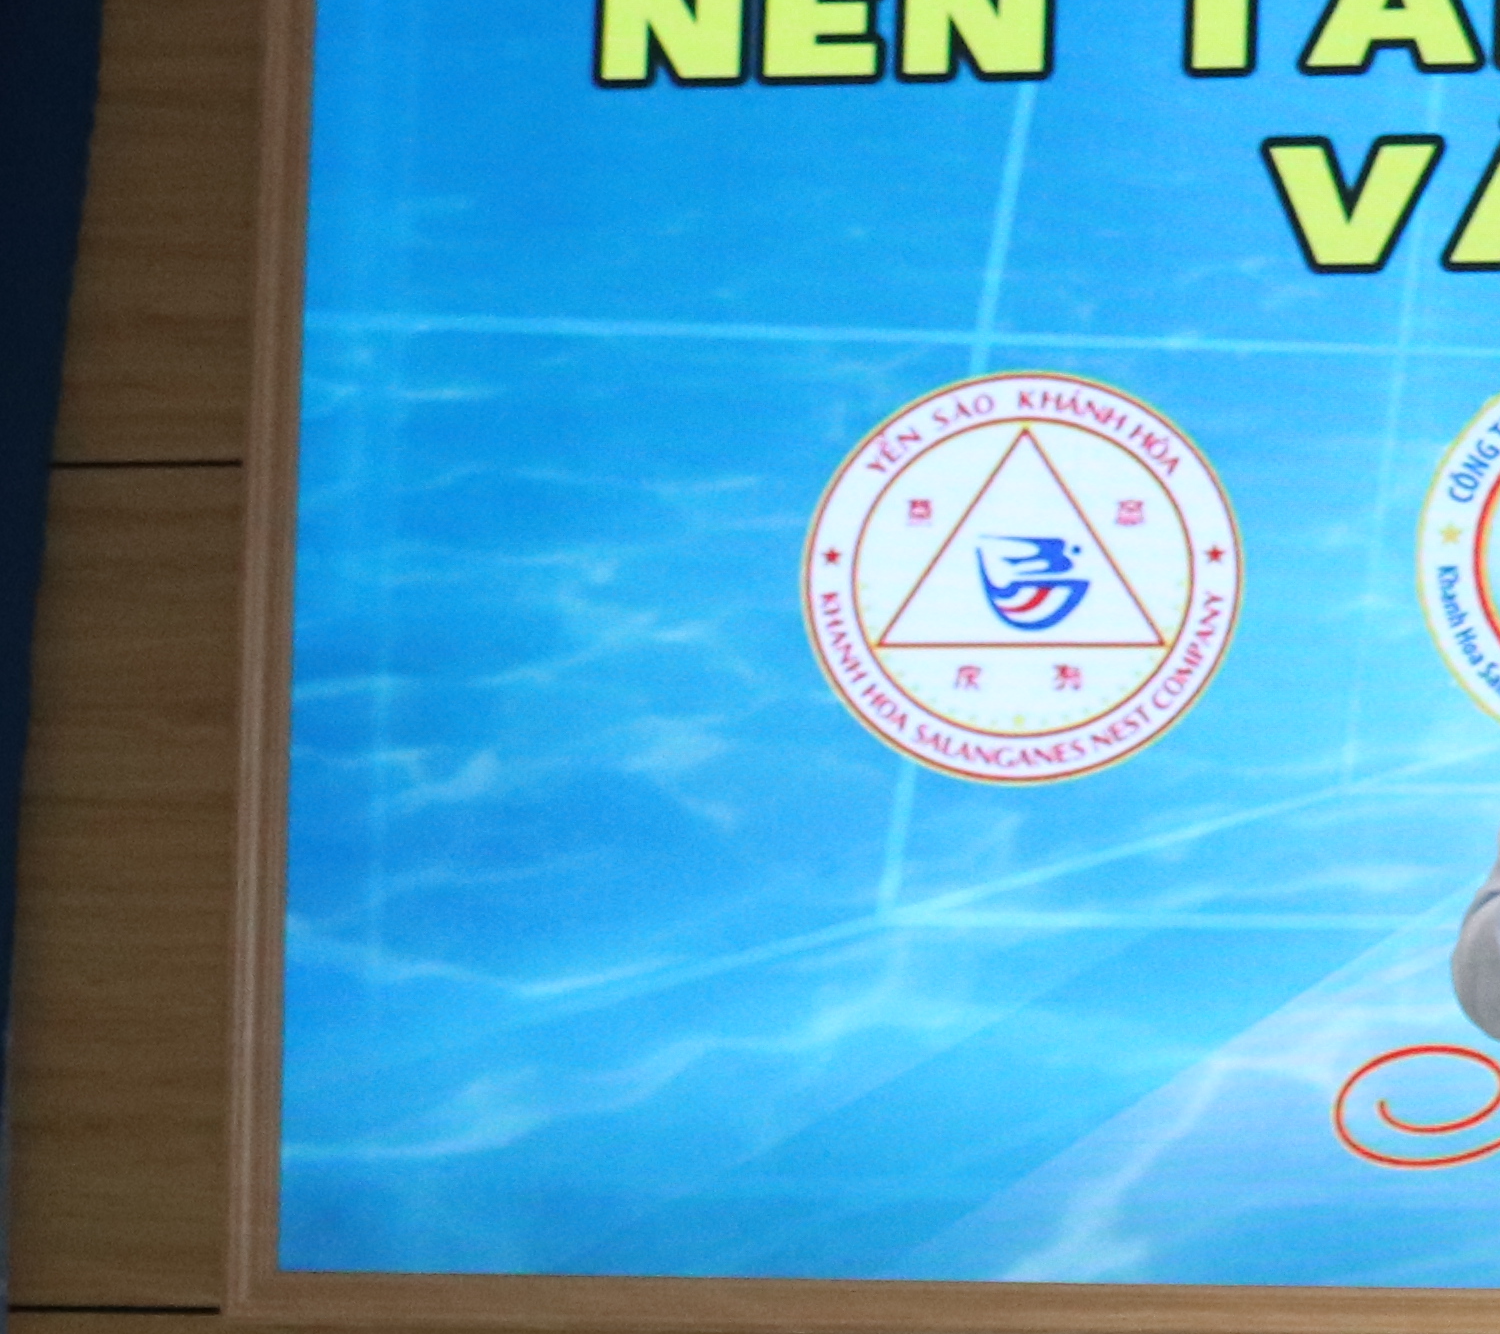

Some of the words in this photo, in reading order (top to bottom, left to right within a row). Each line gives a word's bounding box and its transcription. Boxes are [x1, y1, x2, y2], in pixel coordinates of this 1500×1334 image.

[1018, 386, 1127, 433] KHÁNH
[1447, 438, 1500, 504] CÔNG
[1455, 626, 1484, 667] Hoa
[819, 591, 863, 685] KHANH
[861, 681, 909, 733] HOA
[913, 722, 1088, 768] SALANGANES
[1089, 703, 1152, 751] NEST
[1148, 591, 1226, 712] COMPANY
